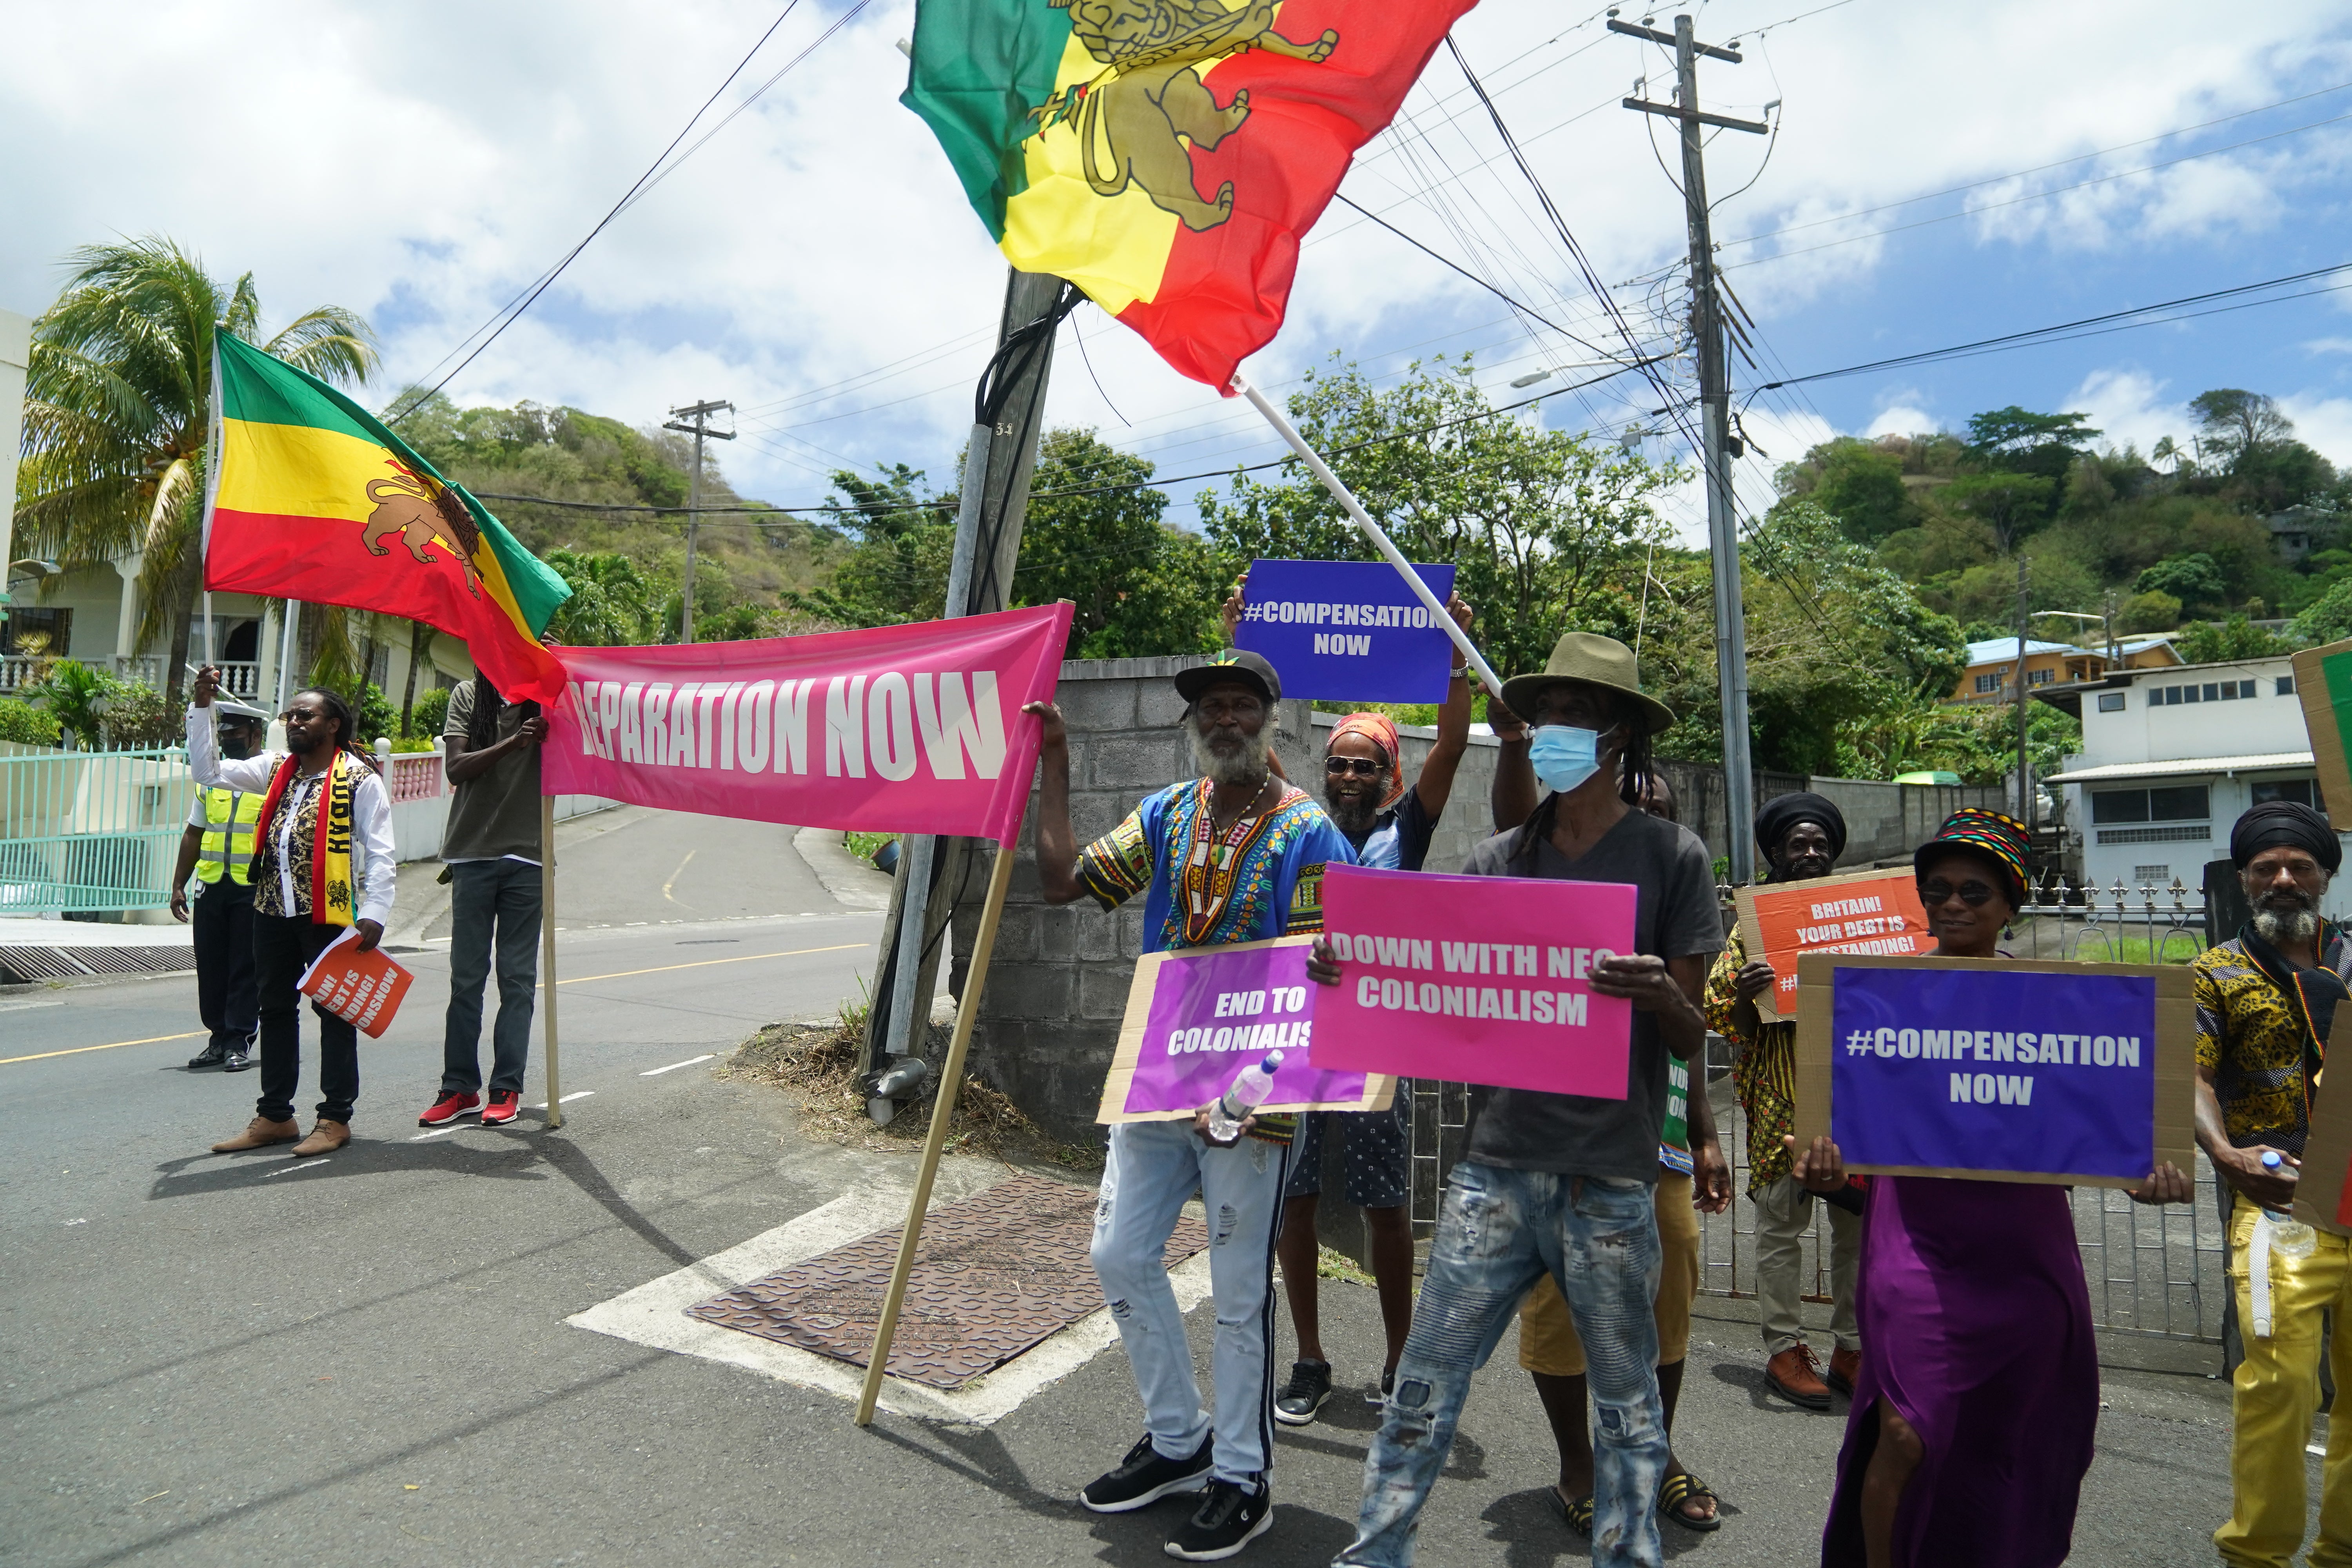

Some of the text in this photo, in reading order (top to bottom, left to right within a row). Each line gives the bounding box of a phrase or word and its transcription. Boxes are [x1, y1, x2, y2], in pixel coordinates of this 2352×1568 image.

[996, 423, 1013, 436] 31
[1314, 633, 1371, 656] NOW
[566, 670, 1007, 782] REPARATION NOW
[328, 769, 349, 853] JUDAH
[1811, 896, 1882, 920] BRITAIN!
[1796, 915, 1905, 944] YOUR DEBT IS
[1798, 936, 1915, 955] STANDING!
[1331, 932, 1432, 971] DOWN
[1441, 941, 1537, 976] WITH
[323, 969, 359, 1013] EBT IS
[1214, 986, 1307, 1018] END TO
[1356, 976, 1588, 1027] COLONIALISM
[1167, 1020, 1312, 1056] COLONIALIS
[1846, 1028, 2140, 1067] #COMPENSATION
[1949, 1073, 2034, 1106] NOW
[844, 1331, 922, 1340] STATON
[894, 1323, 956, 1332] UCTILE
[850, 1340, 911, 1348] BRON
